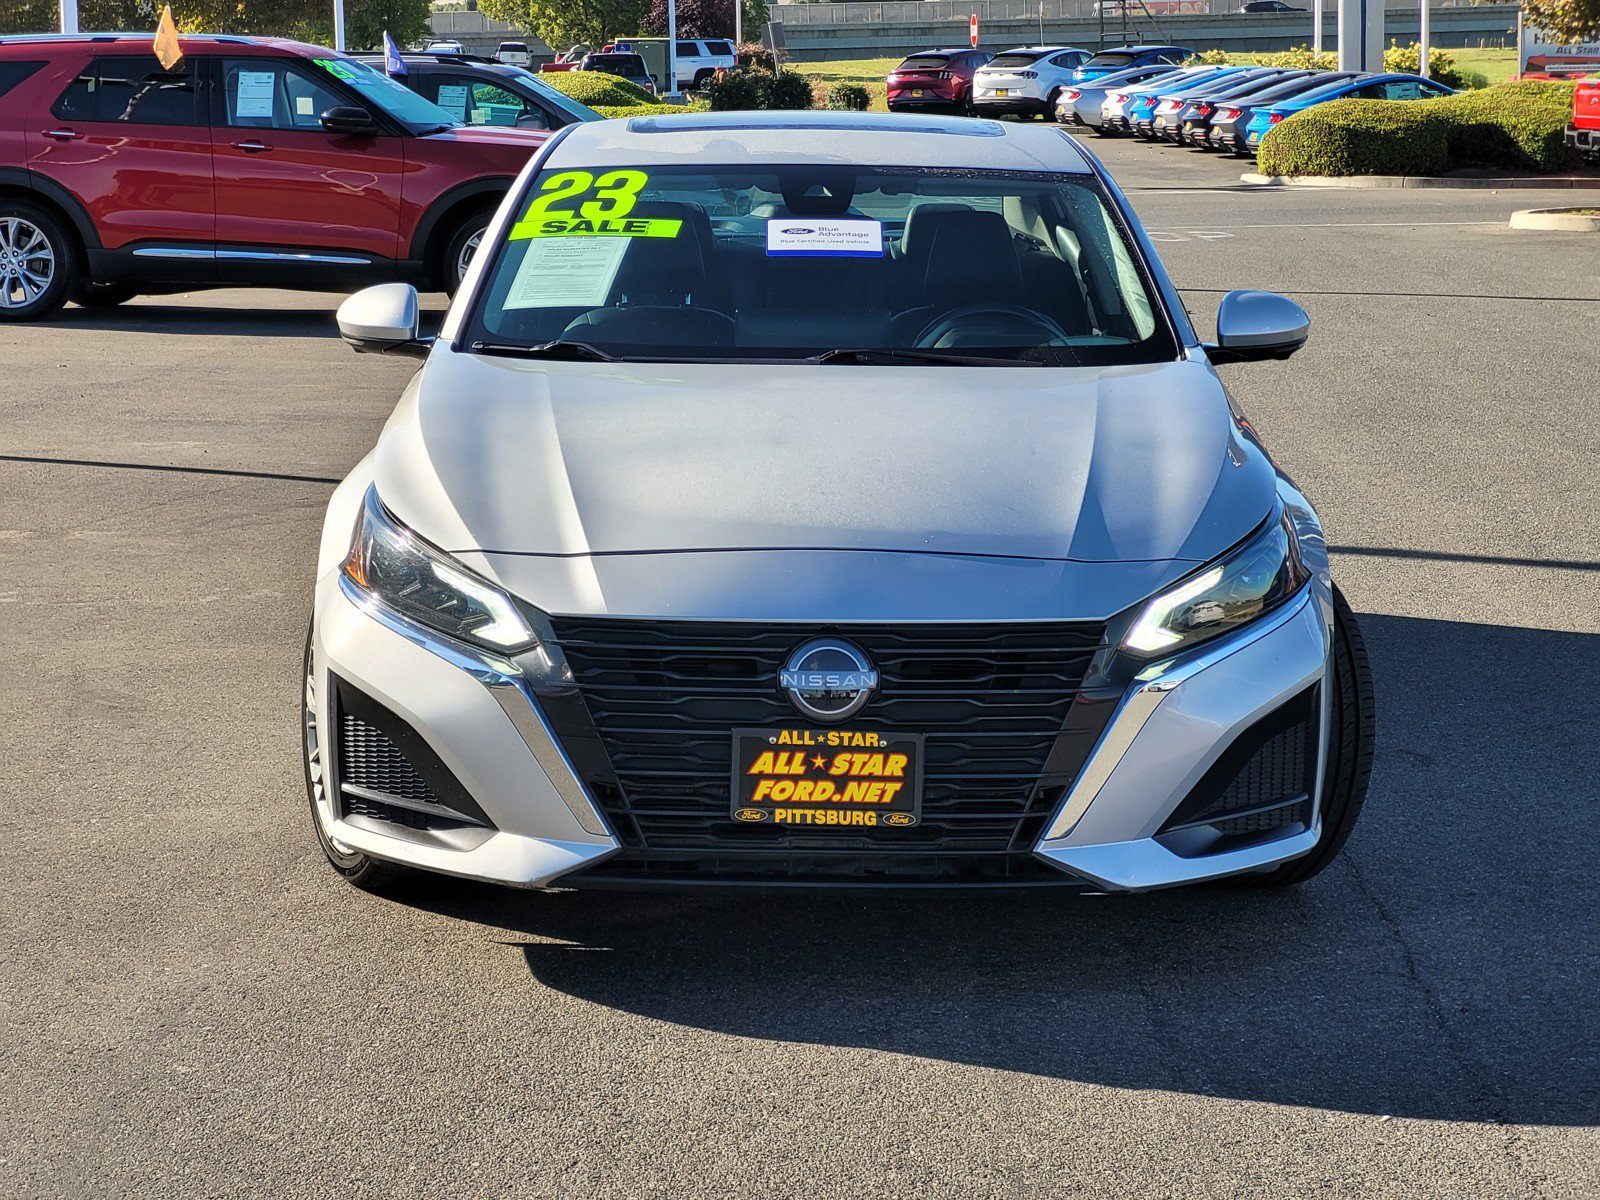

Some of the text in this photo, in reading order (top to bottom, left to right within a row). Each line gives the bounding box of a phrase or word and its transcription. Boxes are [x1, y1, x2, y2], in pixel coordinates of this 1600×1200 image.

[522, 170, 648, 221] 23
[540, 220, 651, 234] SALE
[783, 674, 875, 687] NISSAN
[778, 730, 879, 747] ALL STAR
[747, 750, 908, 777] ALL STAR
[751, 779, 902, 803] FORD.NET
[741, 809, 762, 821] Ford
[774, 808, 877, 826] PITTSBURG
[889, 814, 910, 824] Ford
